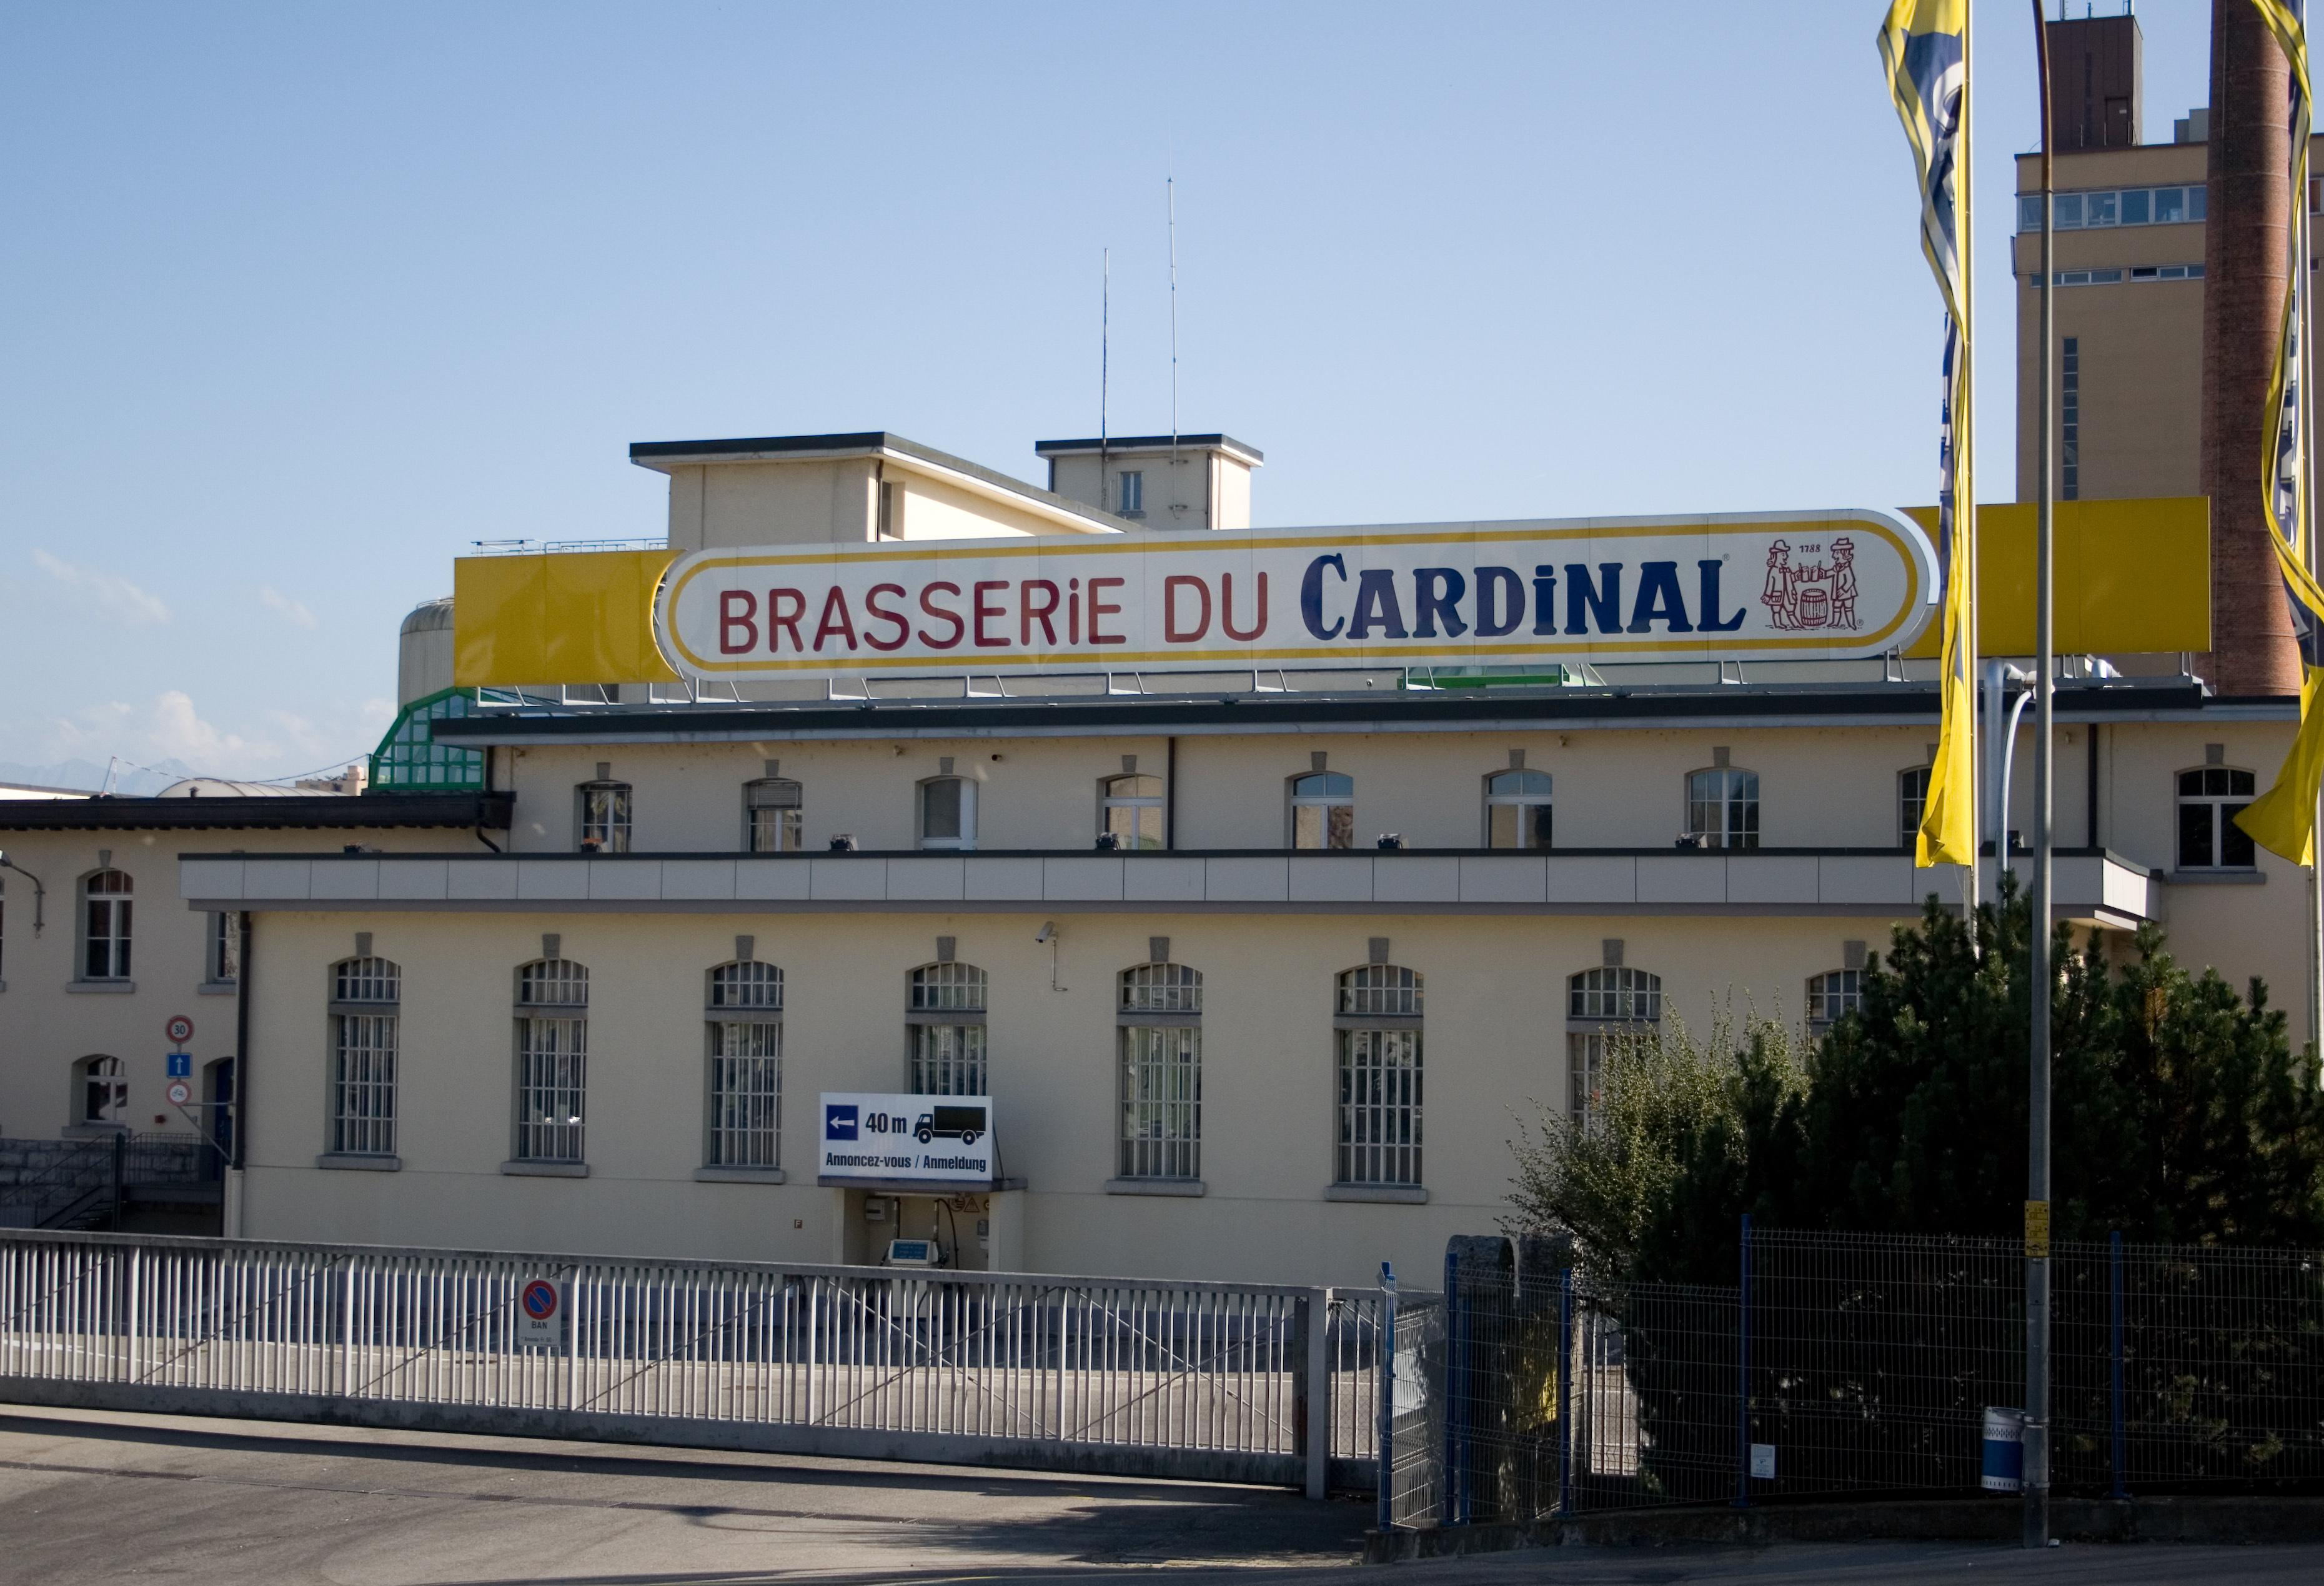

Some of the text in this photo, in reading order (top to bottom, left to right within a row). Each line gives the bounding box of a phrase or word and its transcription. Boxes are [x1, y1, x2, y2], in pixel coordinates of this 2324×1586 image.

[1799, 544, 1820, 553] 1788
[1164, 572, 1268, 642] DU
[174, 1025, 186, 1035] 30
[865, 1112, 907, 1134] 40 m
[826, 1152, 911, 1168] Annoncez-vous
[923, 1155, 986, 1172] Anmeldung
